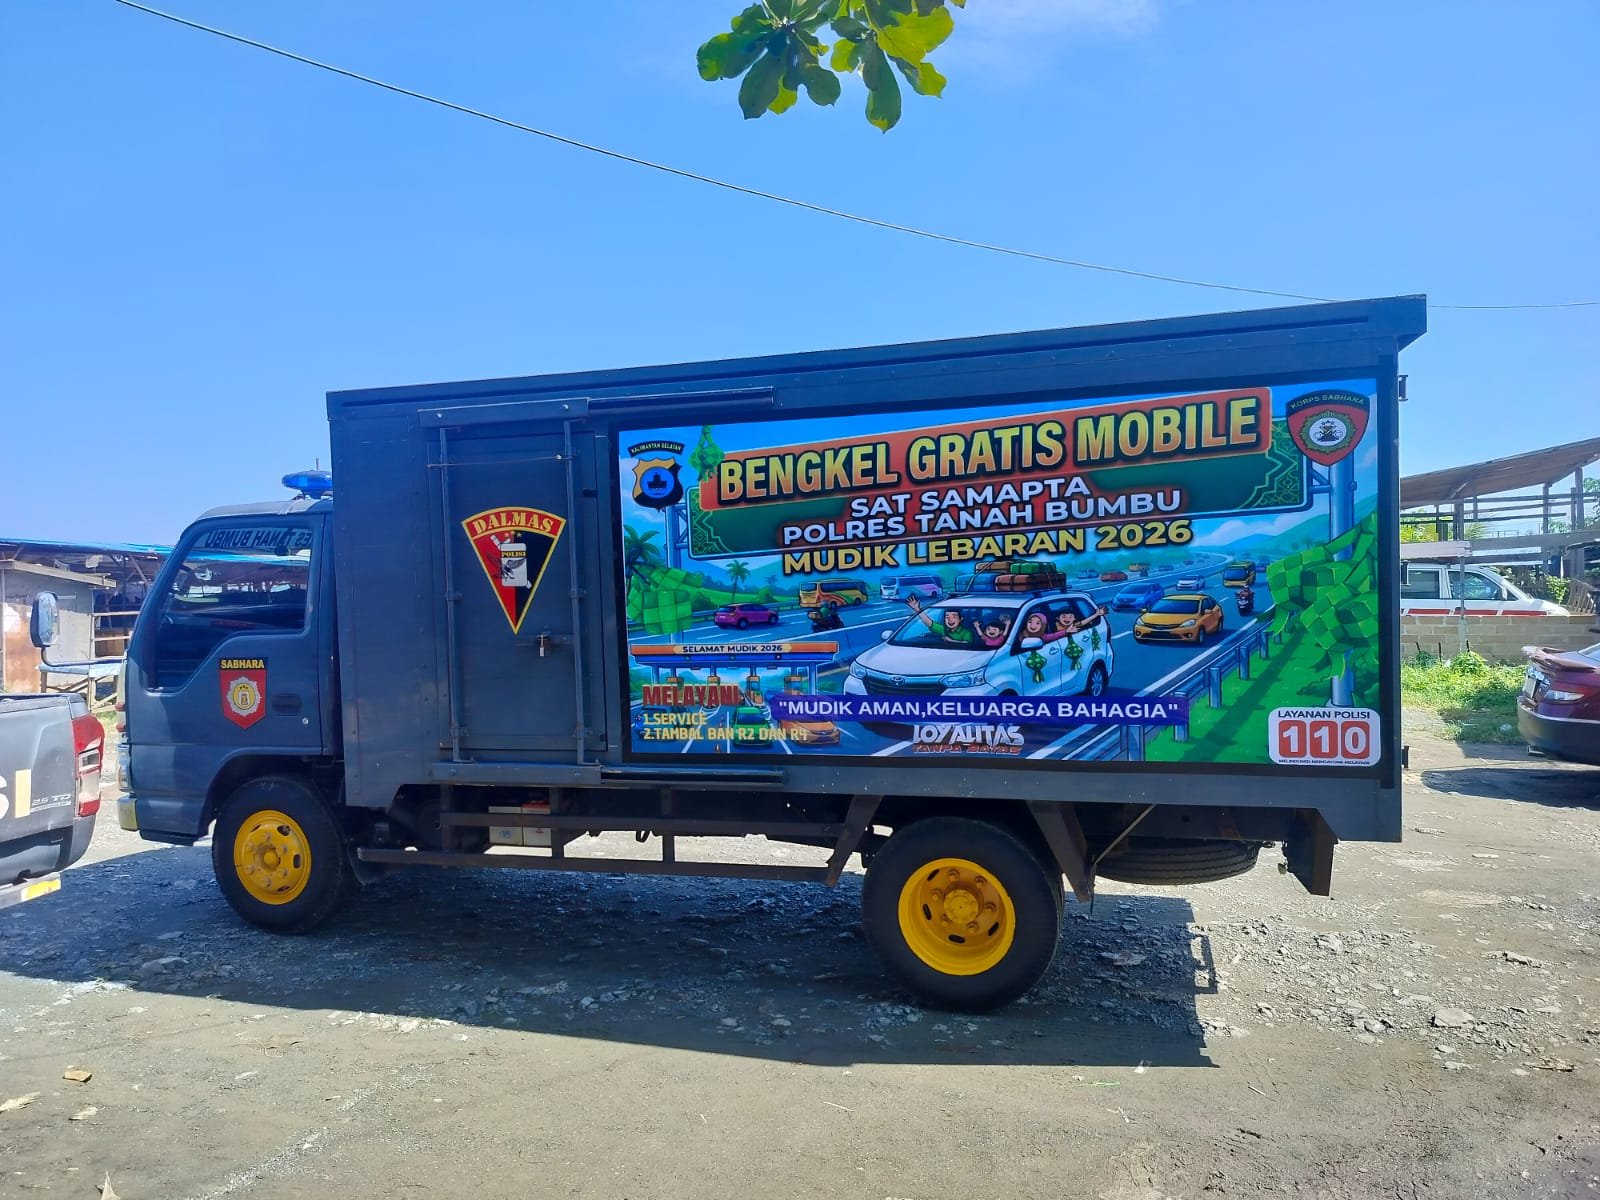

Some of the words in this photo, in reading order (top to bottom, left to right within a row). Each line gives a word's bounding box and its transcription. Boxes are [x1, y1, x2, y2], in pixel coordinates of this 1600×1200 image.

[1290, 396, 1320, 409] KORPS
[720, 443, 898, 500] BENGKEL
[908, 421, 1064, 481] GRATIS
[1077, 398, 1257, 461] MOBILE
[850, 492, 911, 518] SAT
[921, 477, 1090, 510] SAMAPTA
[472, 511, 554, 535] DALMAS
[783, 515, 906, 546] POLRES
[916, 504, 1032, 532] TANAH
[1046, 490, 1181, 522] BUMBU
[783, 545, 899, 575] MUDIK
[908, 528, 1085, 564] LEBARAN
[1097, 519, 1193, 550] 2026
[221, 659, 265, 669] SABHARA
[779, 701, 852, 715] "MUDIK
[859, 701, 1051, 718] AMAN,KELUARGA
[1057, 703, 1178, 719] BAHAGIA"
[1278, 710, 1331, 719] LAYANAN
[1334, 711, 1370, 719] POLISI
[643, 727, 704, 740] 2.TAMBAL
[707, 728, 734, 740] BAN
[738, 728, 755, 740] R2
[758, 729, 786, 740] DAN
[790, 729, 808, 741] R4
[912, 724, 1025, 746] LOYALITAS
[1282, 725, 1367, 755] 110
